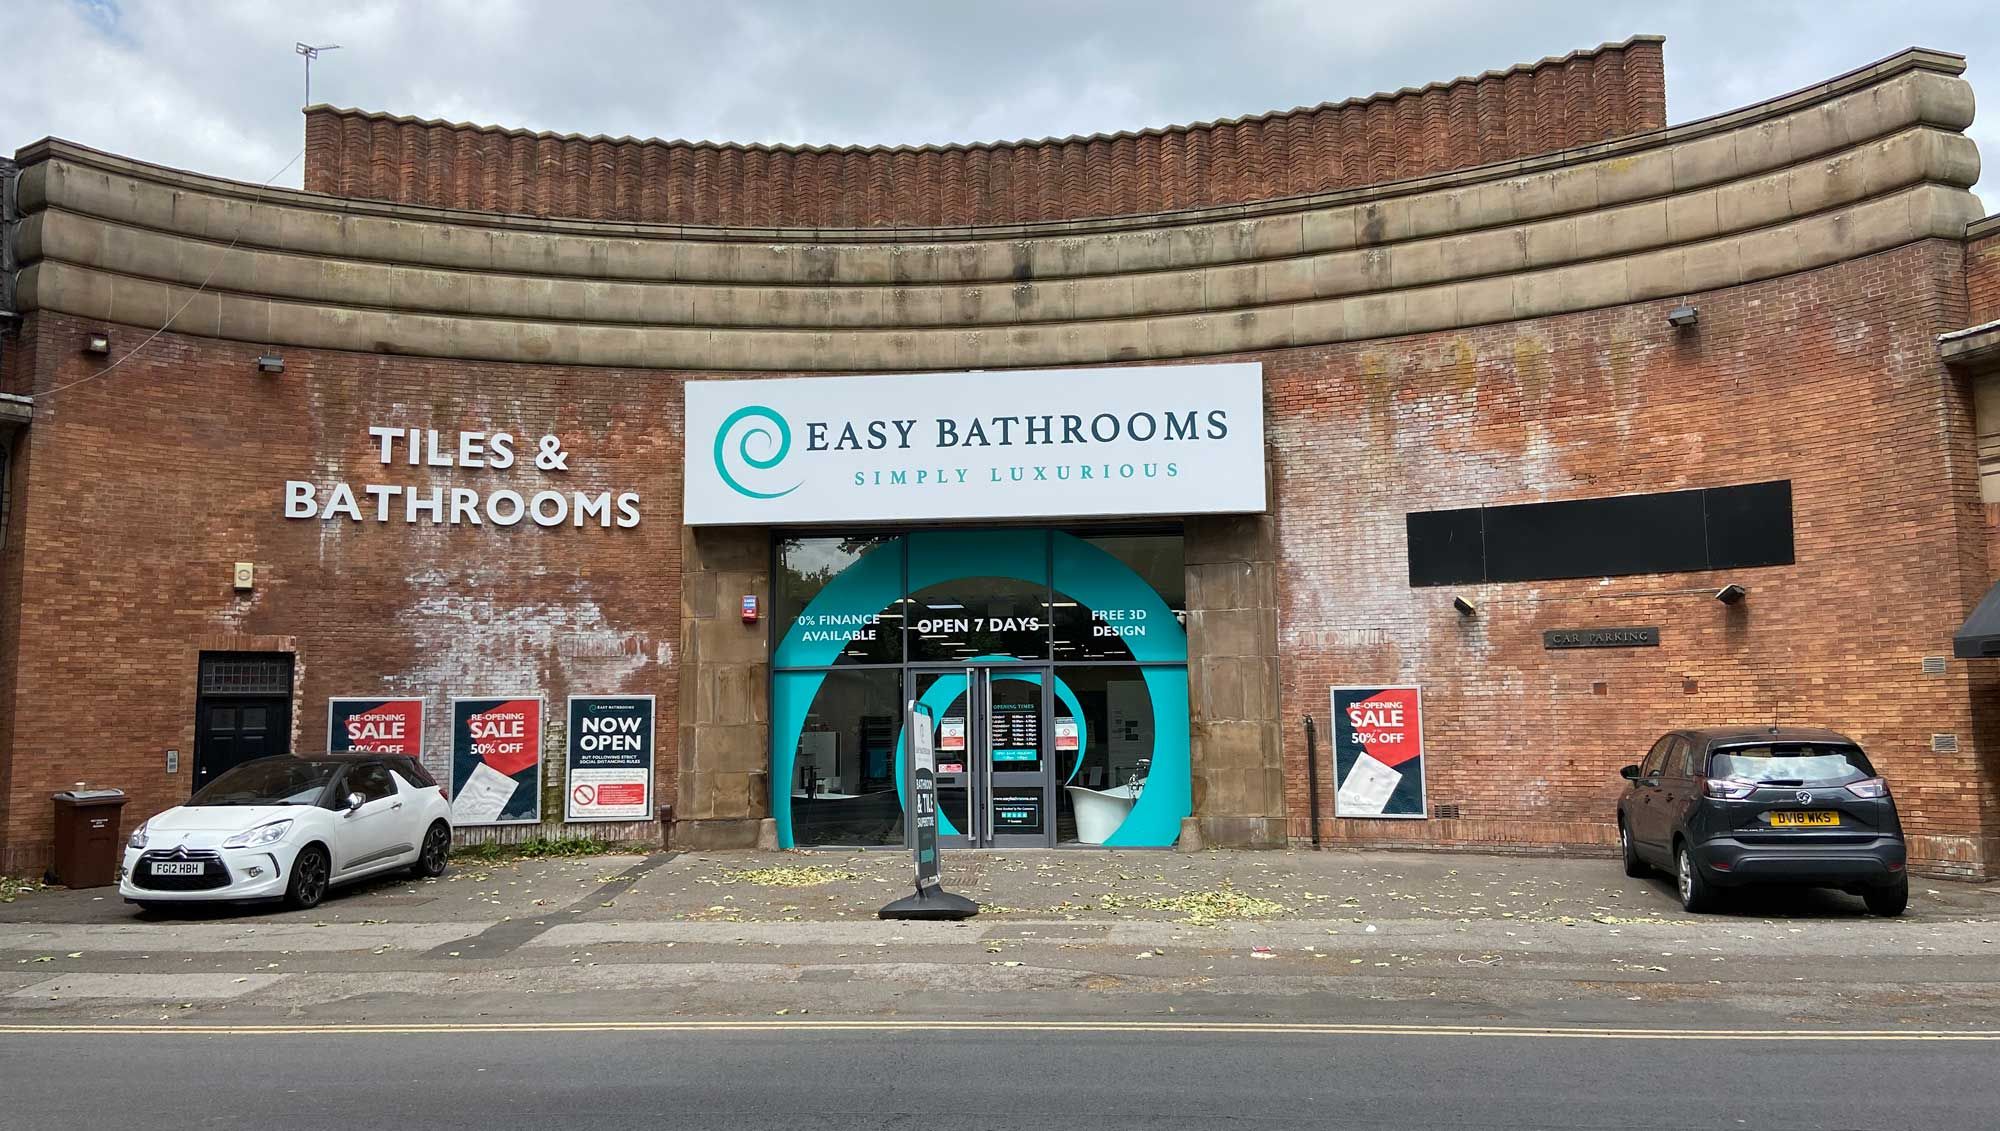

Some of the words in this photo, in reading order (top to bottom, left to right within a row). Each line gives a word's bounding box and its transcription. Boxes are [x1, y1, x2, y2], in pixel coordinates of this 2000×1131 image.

[806, 419, 918, 451] EASY
[935, 410, 1228, 448] BATHROOMS
[369, 426, 515, 469] TILES
[535, 434, 569, 471] &
[854, 468, 968, 486] SIMPLY
[990, 462, 1179, 482] LUXURIOUS
[284, 480, 641, 528] BATHROOMS
[798, 615, 816, 626] 0%
[819, 614, 880, 626] FINANCE
[1091, 609, 1125, 621] FREE
[1129, 609, 1147, 621] 3D
[917, 619, 969, 634] OPEN
[974, 618, 985, 633] 7
[989, 617, 1040, 632] DAYS
[1092, 625, 1146, 637] DESIGN
[801, 629, 877, 642] AVAILABLE
[1552, 633, 1580, 643] CAR
[1589, 631, 1649, 642] PARKING
[1350, 701, 1403, 709] RE-OPENING
[349, 713, 406, 722] RE-OPENING
[471, 712, 525, 721] RE-OPENING
[1350, 710, 1405, 727] SALE
[348, 722, 405, 740] SALE
[470, 721, 525, 738] SALE
[582, 717, 642, 733] NOW
[580, 734, 642, 751] OPEN
[1351, 733, 1377, 744] 50%
[1379, 732, 1405, 744] OFF
[470, 743, 496, 755] 50%
[498, 742, 524, 754] OFF
[922, 793, 934, 814] TILE
[1777, 812, 1805, 824] DV18
[1808, 812, 1831, 823] WKS
[156, 863, 177, 873] FG12
[179, 863, 198, 873] HBH
